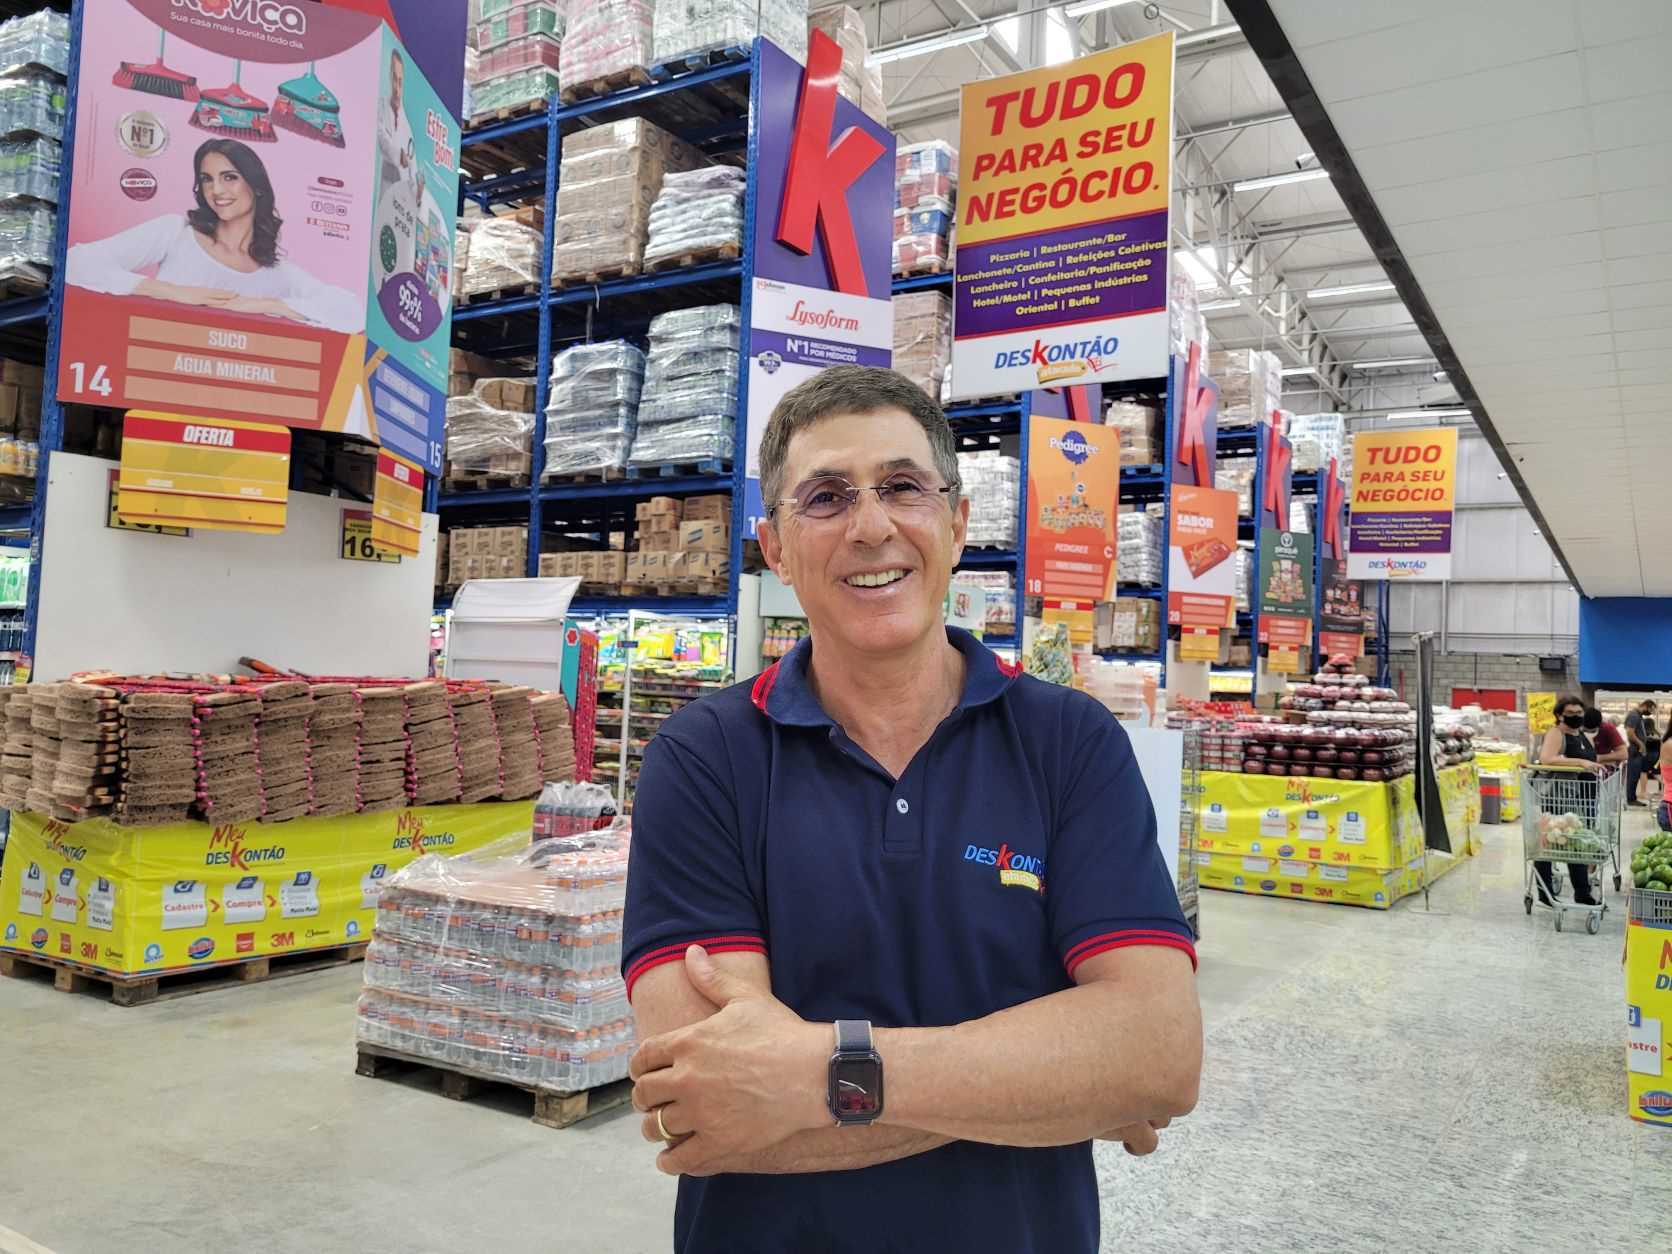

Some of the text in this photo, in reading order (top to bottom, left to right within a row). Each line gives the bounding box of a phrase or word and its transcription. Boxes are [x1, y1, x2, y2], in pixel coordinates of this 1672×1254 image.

[170, 11, 188, 24] Sua
[190, 17, 211, 28] casa
[213, 22, 235, 33] mais
[236, 27, 265, 41] bonita
[267, 35, 289, 46] todo
[985, 62, 1146, 136] TUDO
[972, 118, 1155, 182] PARA SEU
[965, 161, 1159, 225] NEGÓCIO.
[957, 240, 1168, 283] Lanchonete/Cantina Refeições Coletivas
[990, 232, 1127, 264] Pizzaria Restaurante/Bar
[970, 258, 1152, 294] Lancheiro Confeitaria/Panificação
[973, 272, 1148, 308] Hotel/Motel Pequenas Indústrias
[786, 300, 859, 331] Lysoform
[1016, 295, 1100, 316] Oriental Buffet
[208, 330, 247, 350] SUCO
[69, 362, 113, 397] 14
[173, 353, 278, 384] ÁGUA MINERAL
[183, 425, 235, 447] OFERTA
[429, 440, 441, 468] 15
[1366, 445, 1442, 466] TUDO
[1360, 470, 1446, 484] PARA SEU
[81, 941, 98, 960] 3M
[271, 932, 295, 948] 3M
